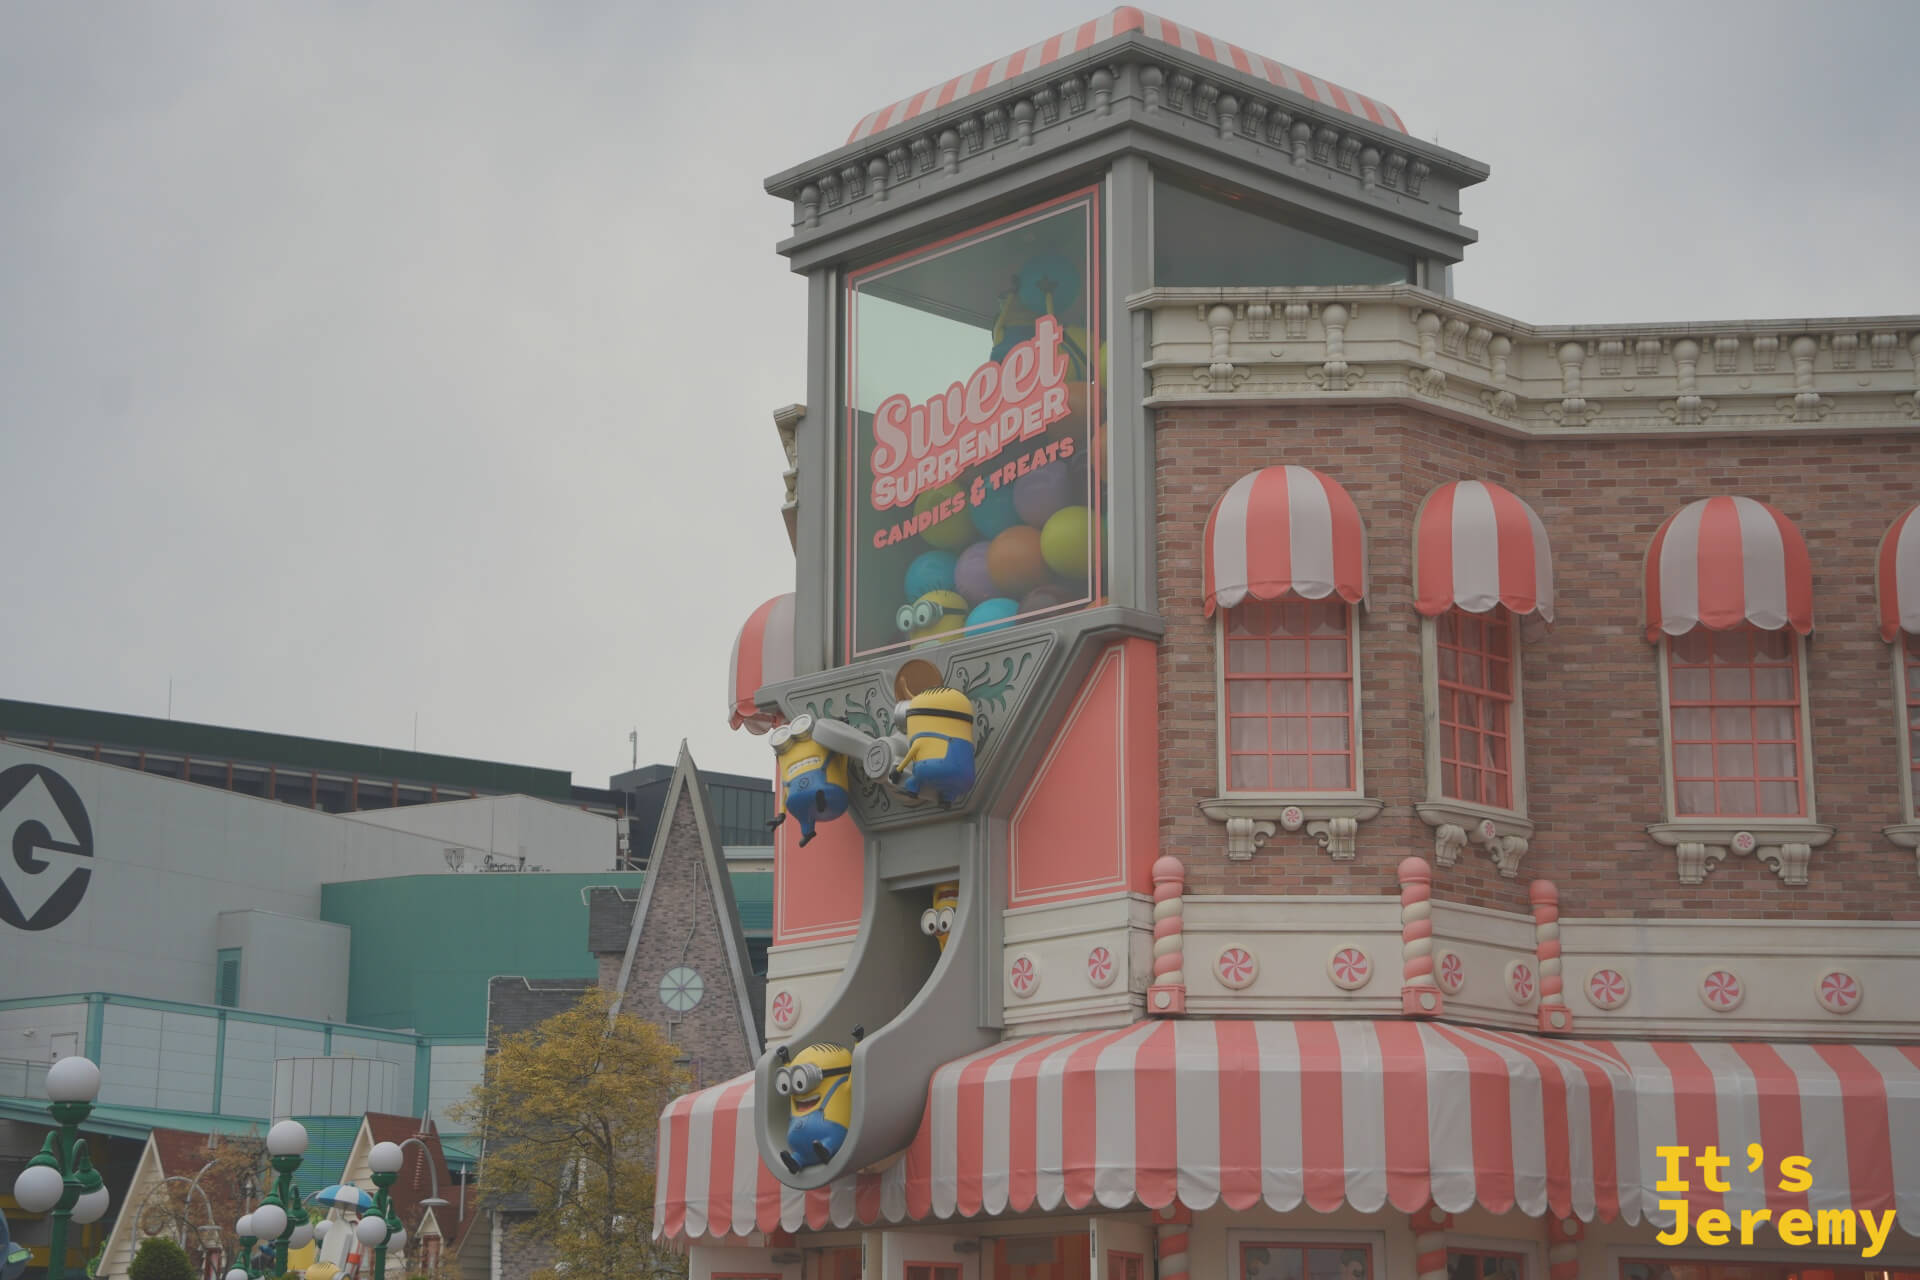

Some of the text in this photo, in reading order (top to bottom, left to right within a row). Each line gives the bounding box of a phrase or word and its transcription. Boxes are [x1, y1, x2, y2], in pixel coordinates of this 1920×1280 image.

[872, 317, 1066, 475] Sweet
[873, 387, 1068, 506] SURRENDER
[873, 437, 1075, 548] CANDIES & TREATS
